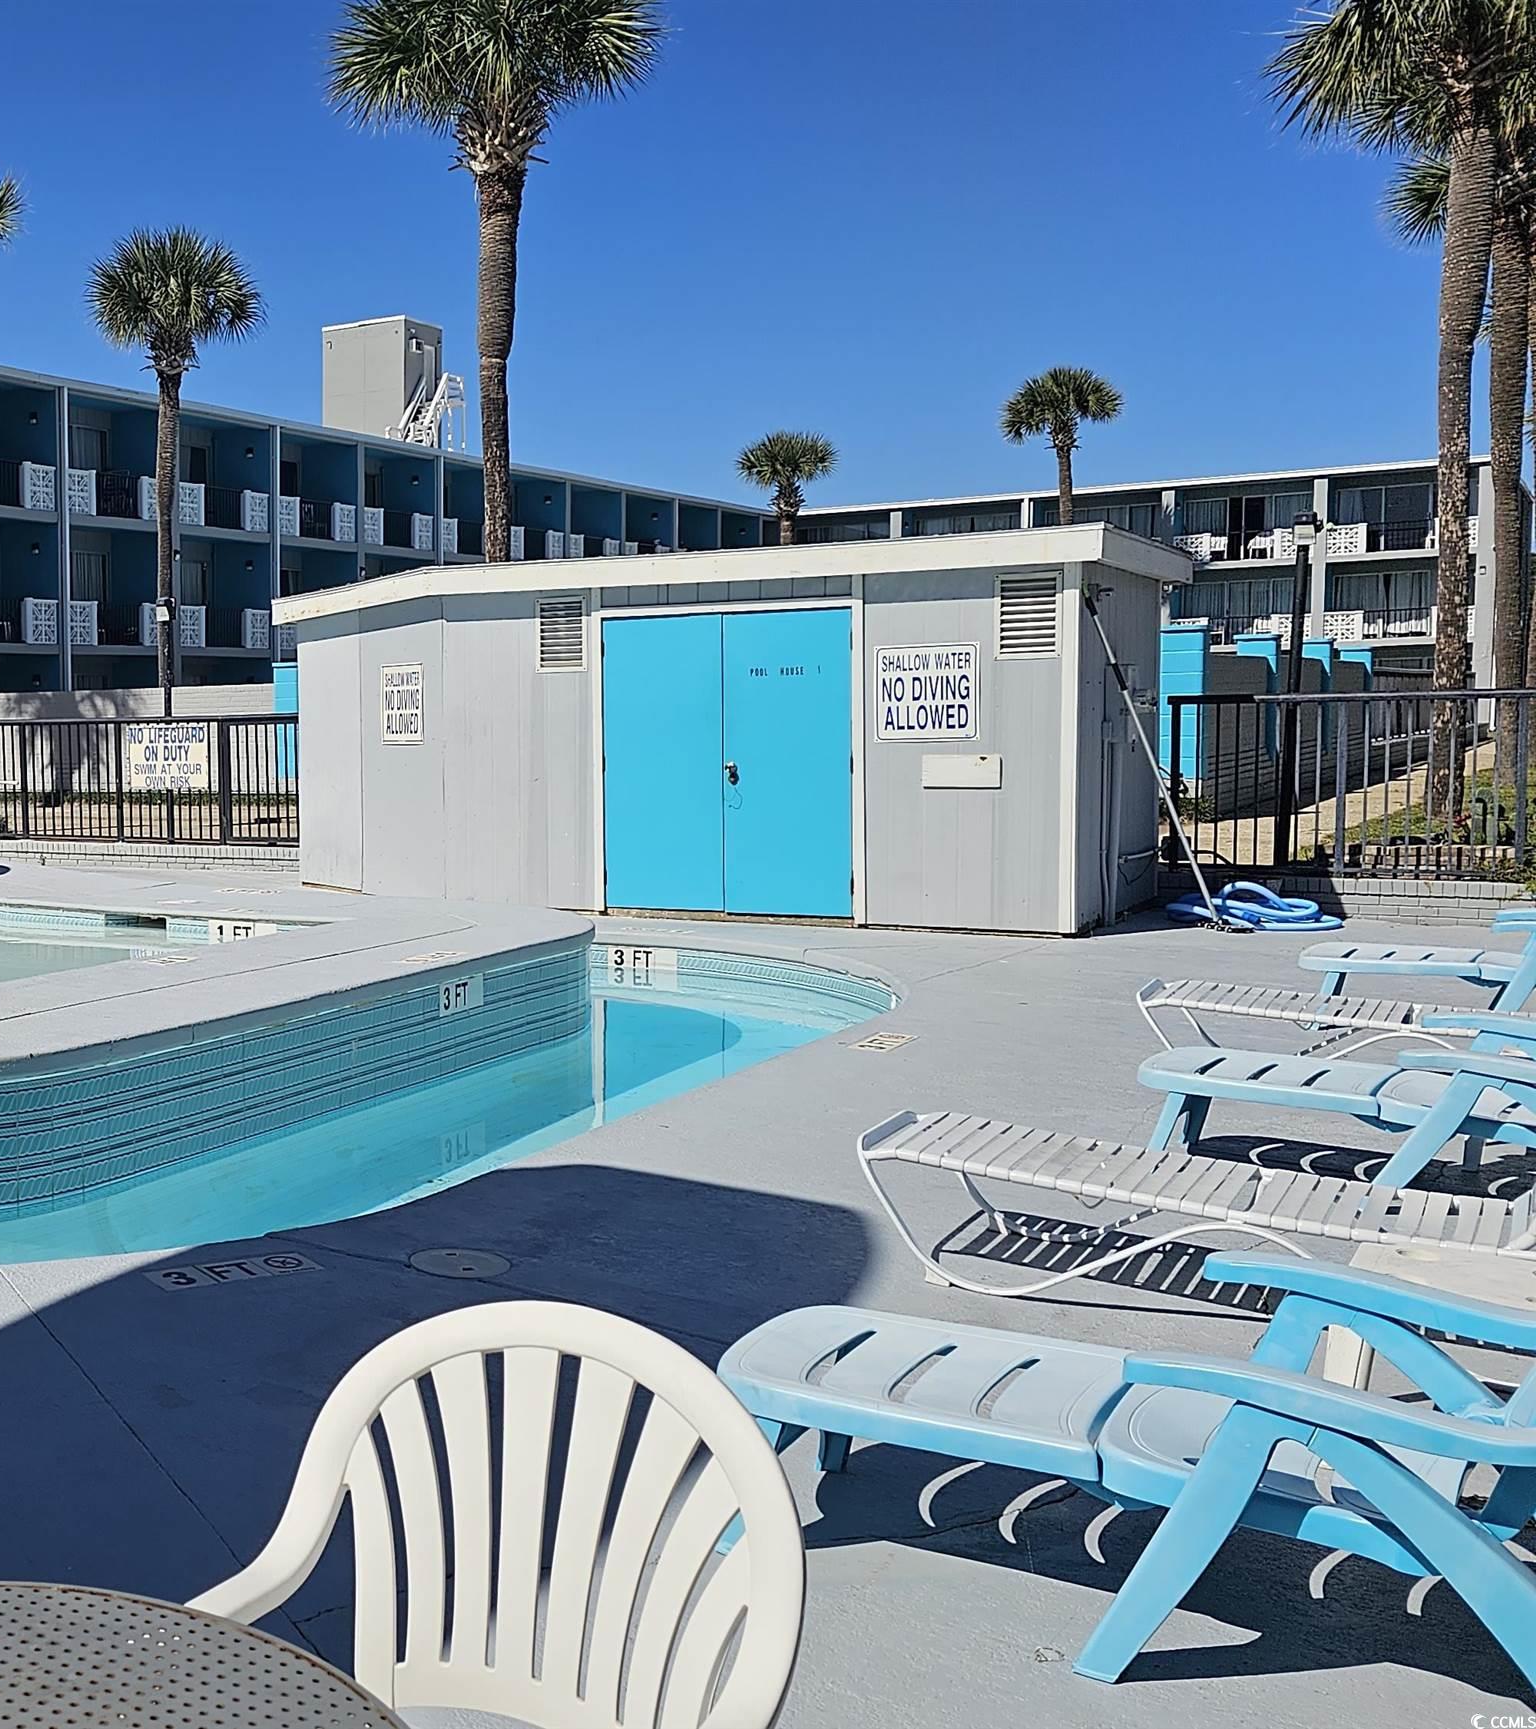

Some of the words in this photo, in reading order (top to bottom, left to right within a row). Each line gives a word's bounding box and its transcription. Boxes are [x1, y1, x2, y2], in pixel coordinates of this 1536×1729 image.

[750, 667, 768, 677] POOL
[780, 666, 804, 676] HOUSE
[882, 654, 930, 672] SHALLOW
[935, 652, 971, 670] WATER
[882, 677, 904, 702] NO
[912, 674, 970, 701] DIVING
[385, 689, 394, 711] NO
[397, 688, 419, 711] DIVING
[386, 713, 418, 734] ALLOWED
[885, 704, 968, 730] ALLOWED
[128, 728, 143, 744] NO
[149, 727, 205, 743] LIFEGUARD
[144, 746, 158, 761] ON
[164, 745, 190, 761] DUTY
[134, 764, 156, 775] SWIM
[161, 764, 172, 775] AT
[177, 764, 202, 775] YOUR
[145, 776, 166, 788] OWN
[170, 776, 190, 788] RISK
[217, 925, 224, 938] 1
[233, 926, 252, 939] FT
[614, 949, 624, 966] 3
[633, 950, 652, 968] FT
[444, 987, 450, 1010] 3
[455, 982, 468, 1008] FT
[163, 1271, 197, 1285] 3
[204, 1262, 257, 1280] FT
